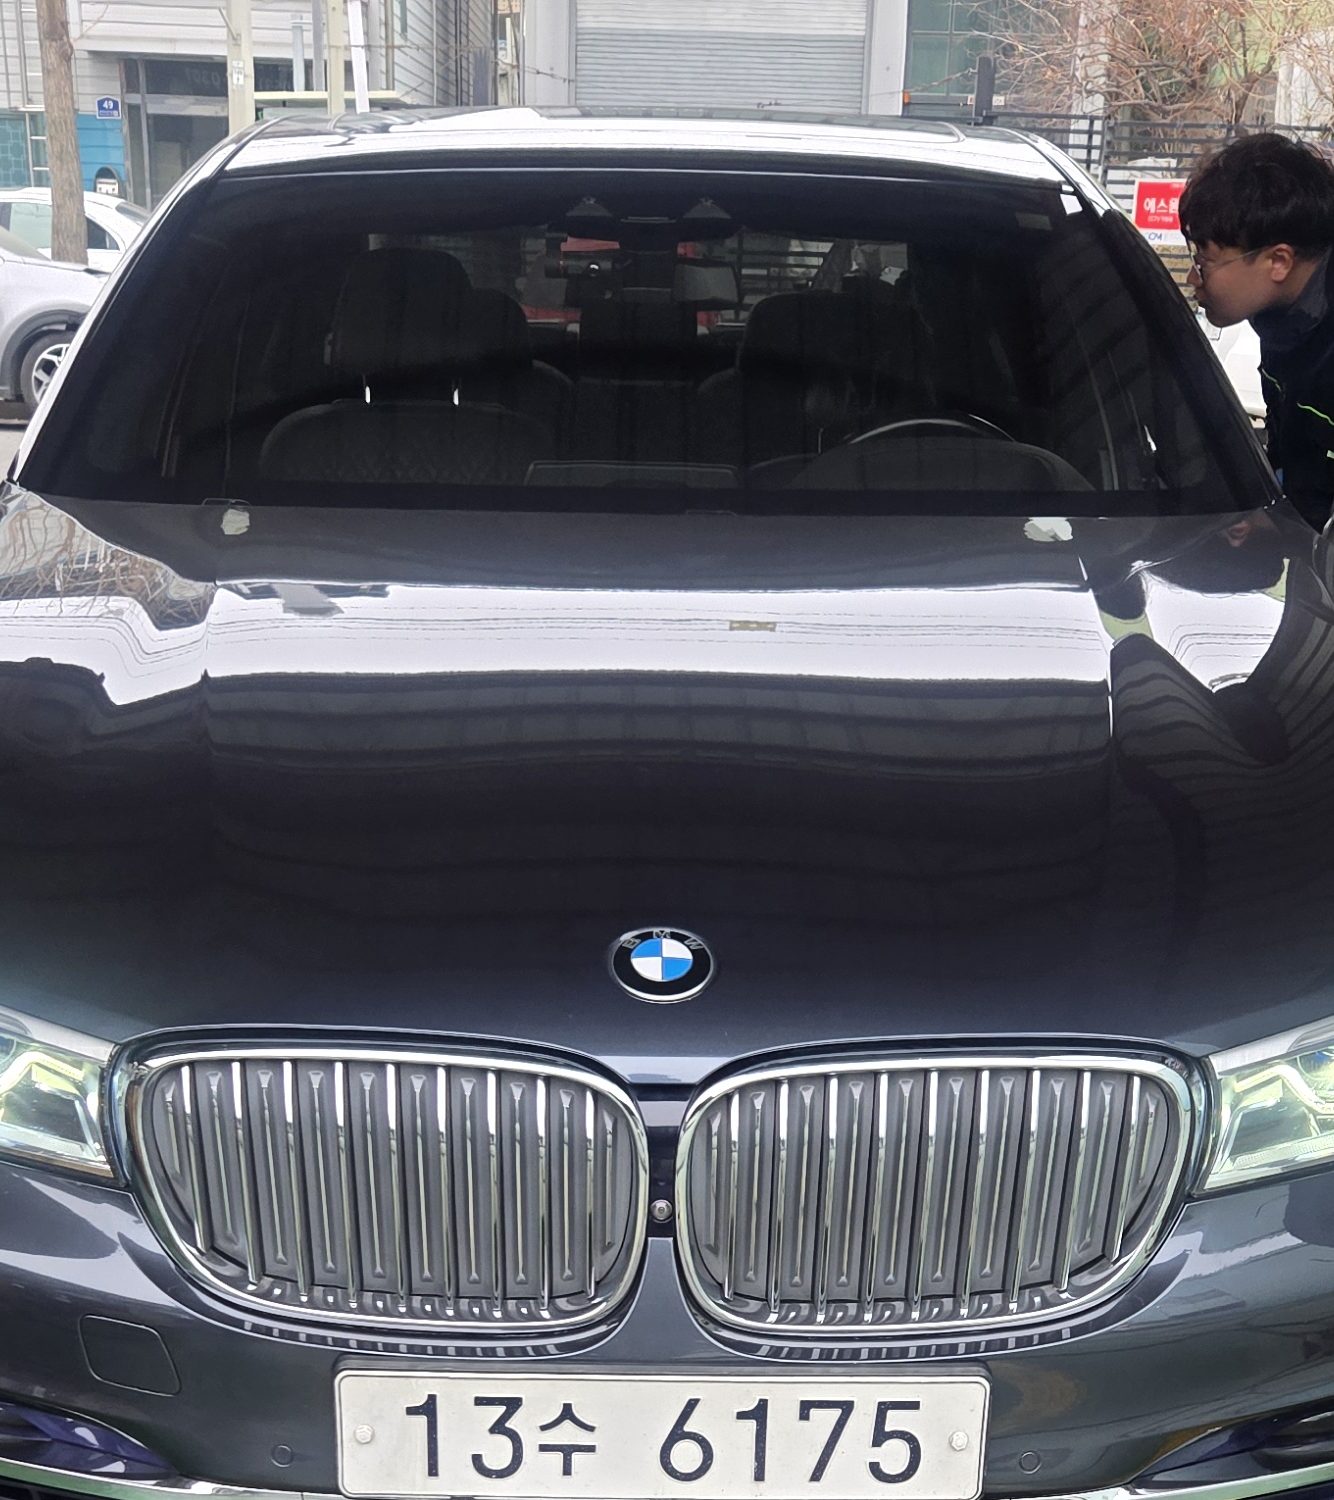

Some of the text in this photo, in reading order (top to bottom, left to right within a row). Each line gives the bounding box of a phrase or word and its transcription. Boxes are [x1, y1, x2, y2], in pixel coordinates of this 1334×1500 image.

[102, 100, 114, 110] 49
[622, 930, 703, 950] BMW
[405, 1393, 922, 1484] 13수 6175
